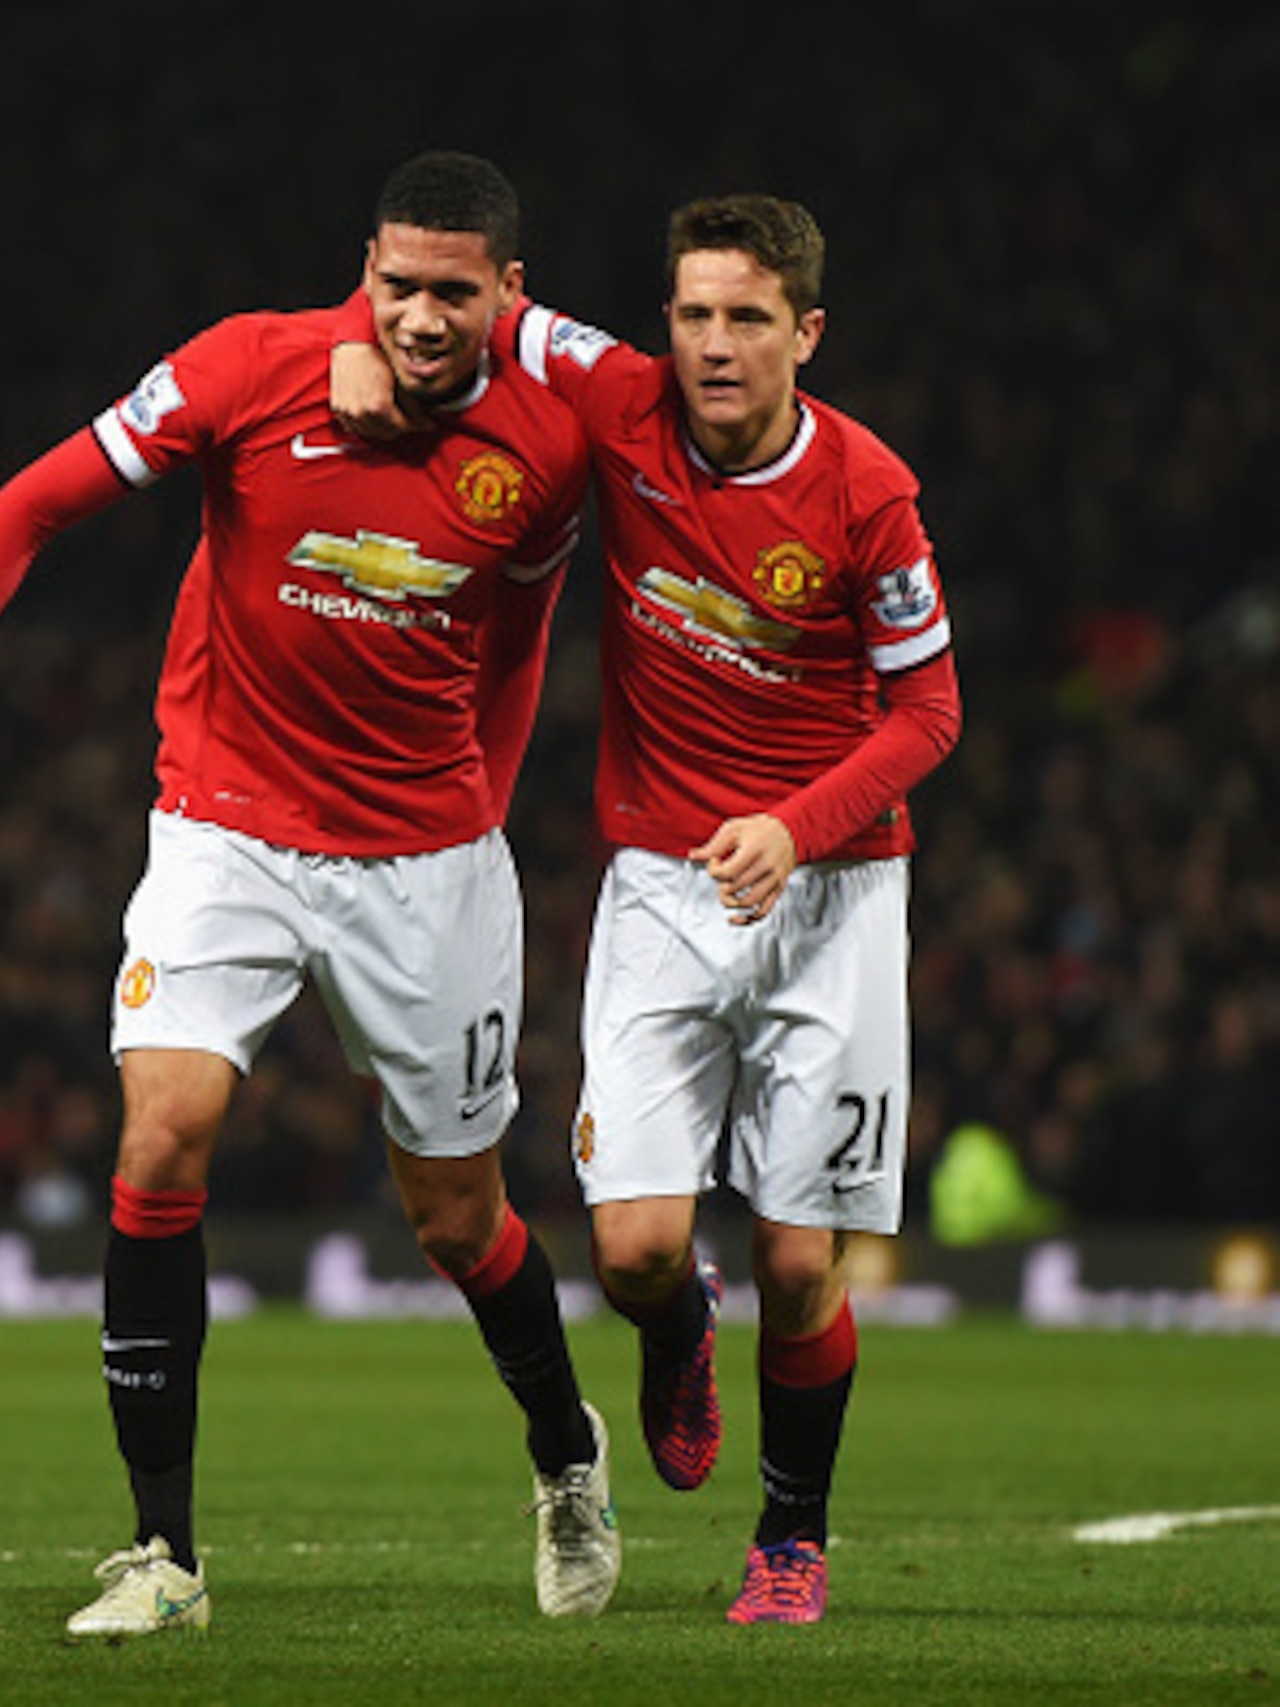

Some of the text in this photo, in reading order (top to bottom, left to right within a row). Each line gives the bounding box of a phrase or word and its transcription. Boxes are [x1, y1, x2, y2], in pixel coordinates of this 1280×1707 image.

[277, 583, 452, 631] CHEVRT
[458, 1008, 504, 1098] 12
[823, 1087, 892, 1172] 21
